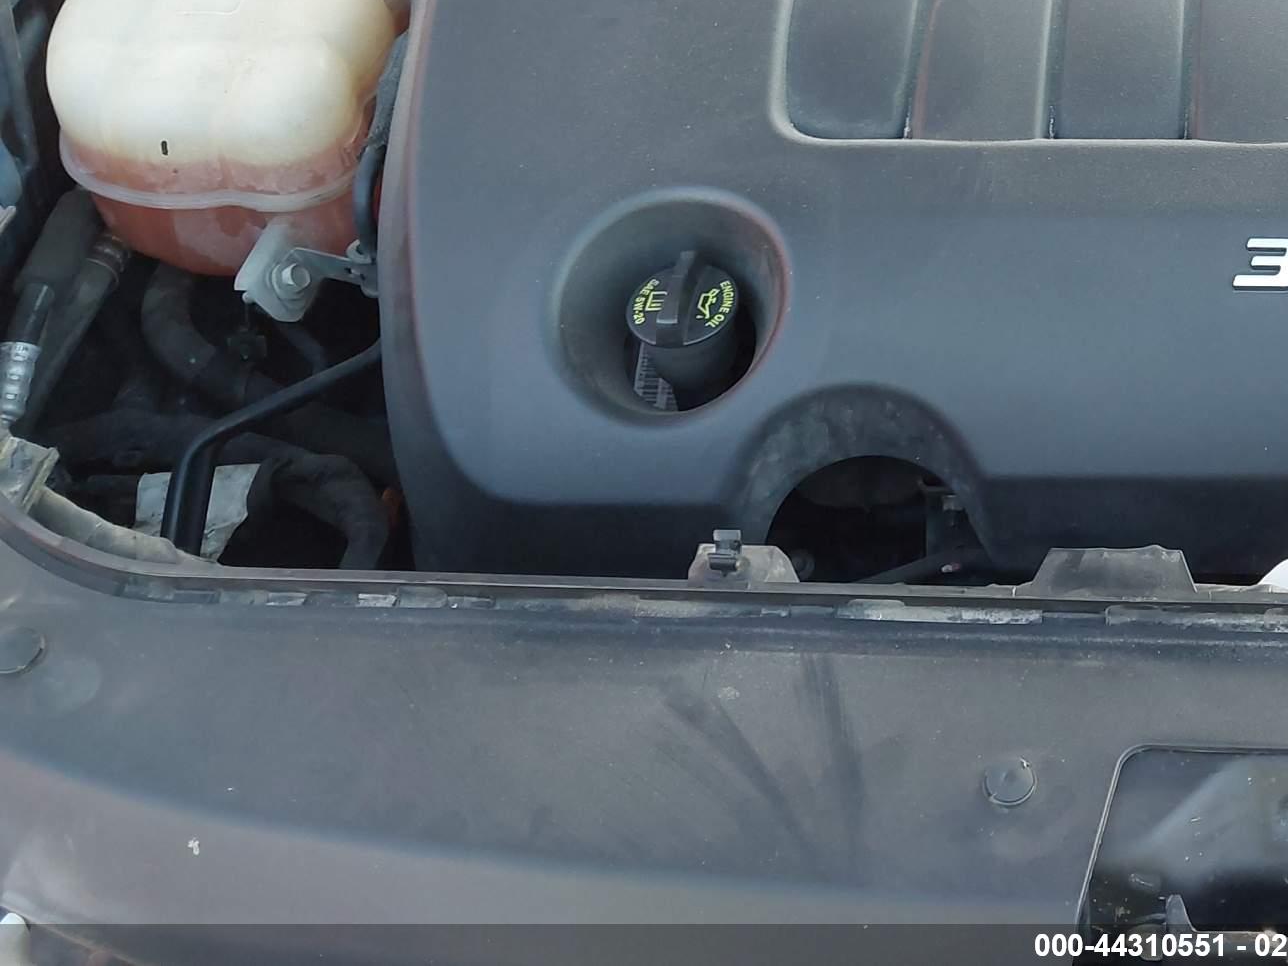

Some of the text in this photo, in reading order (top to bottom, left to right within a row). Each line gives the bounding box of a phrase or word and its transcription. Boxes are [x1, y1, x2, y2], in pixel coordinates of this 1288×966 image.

[640, 278, 659, 296] SAE
[705, 280, 735, 328] ENGINE OIL
